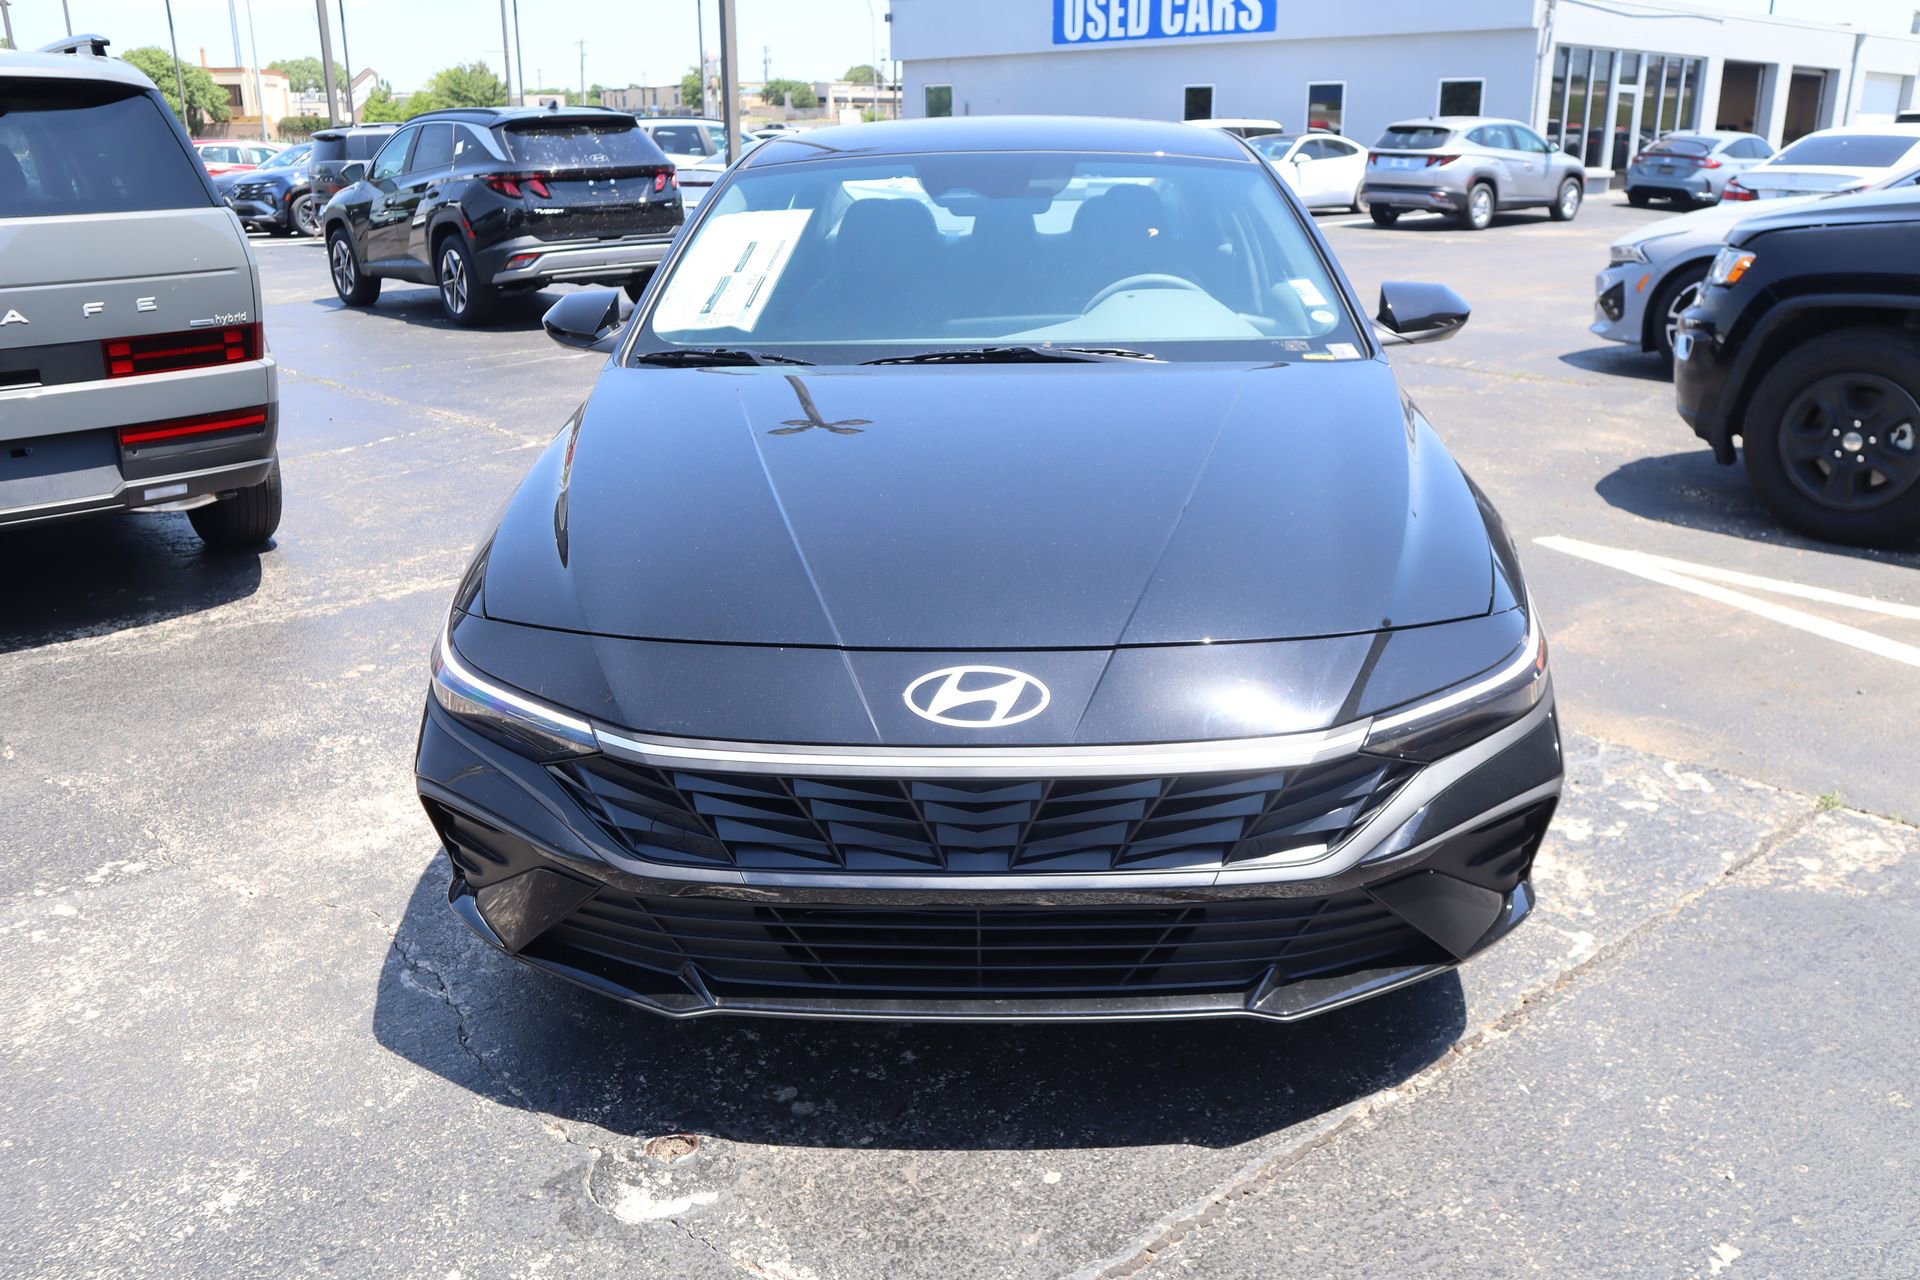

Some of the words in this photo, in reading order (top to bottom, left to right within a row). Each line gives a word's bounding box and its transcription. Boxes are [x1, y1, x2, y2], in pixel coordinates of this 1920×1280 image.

[1063, 0, 1150, 41] USED
[1160, 0, 1264, 36] CARS
[214, 311, 247, 325] hybrid
